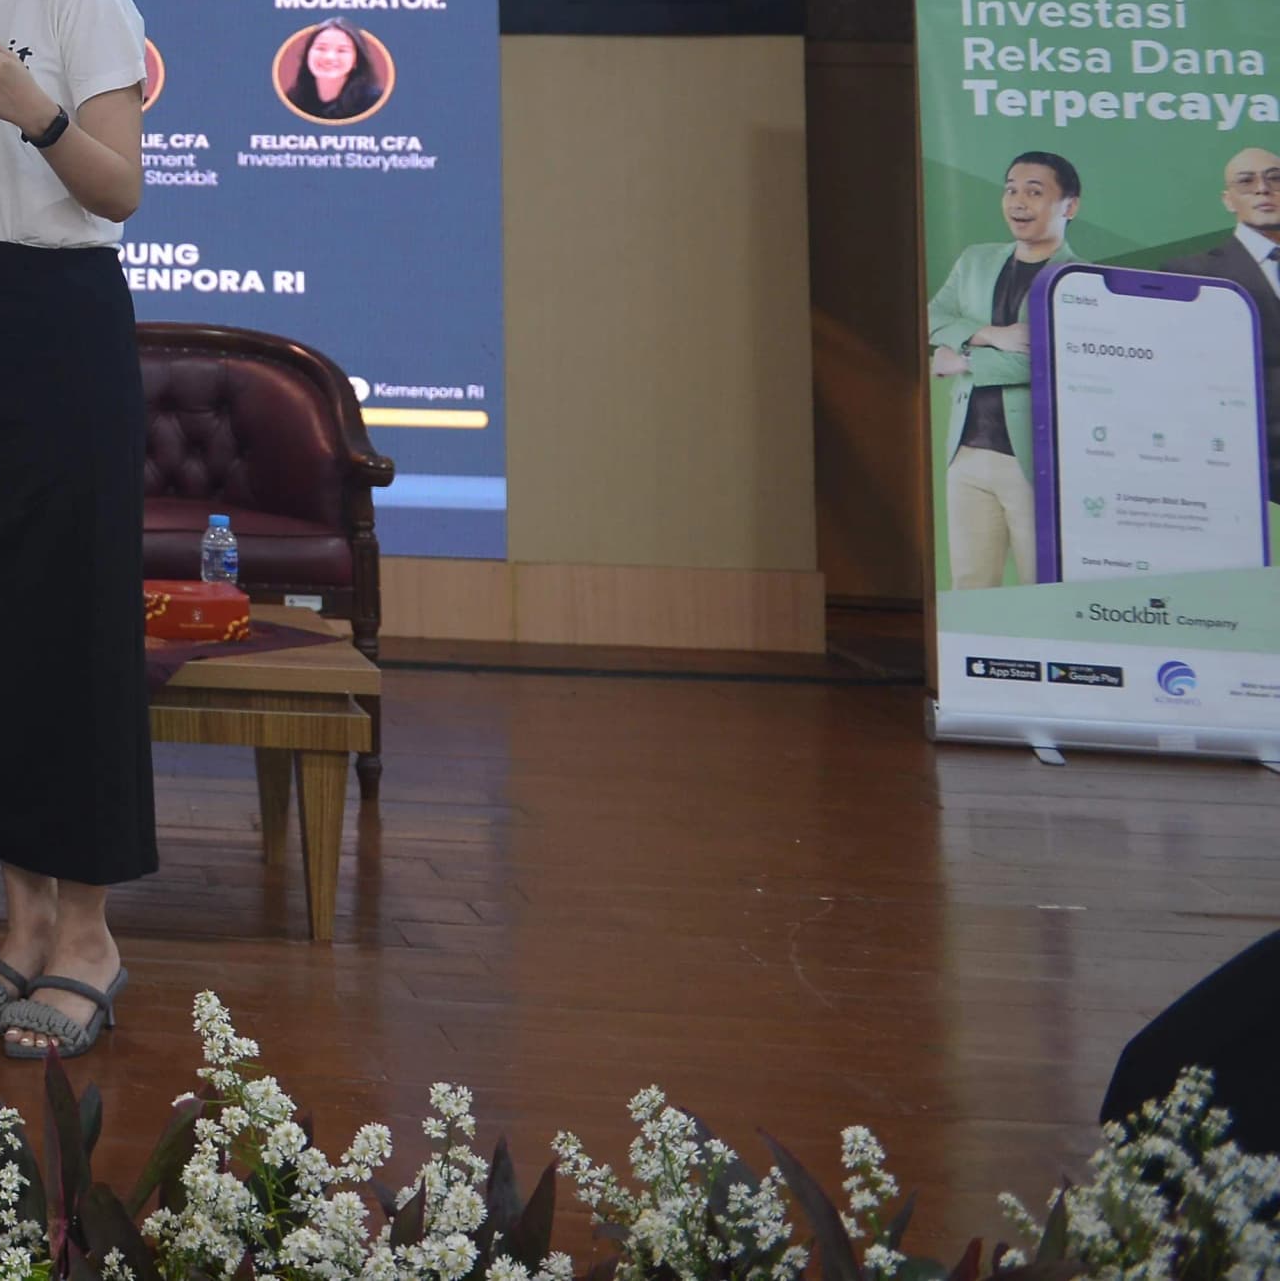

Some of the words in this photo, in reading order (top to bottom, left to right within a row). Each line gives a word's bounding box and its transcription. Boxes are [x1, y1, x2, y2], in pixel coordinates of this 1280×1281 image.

[964, 37, 1112, 72] Reksa
[1132, 40, 1266, 76] Dana
[963, 79, 1280, 131] Terpercaya
[169, 133, 210, 148] CFA
[250, 134, 319, 150] FELICIA
[380, 136, 422, 151] CFA
[237, 151, 341, 168] Investment
[345, 152, 437, 173] Storyteller
[273, 270, 306, 294] RI
[1081, 342, 1154, 360] 10,000,000
[466, 384, 485, 400] RI
[1089, 602, 1171, 625] Stockbit
[989, 668, 1009, 678] App
[1010, 669, 1036, 679] Store
